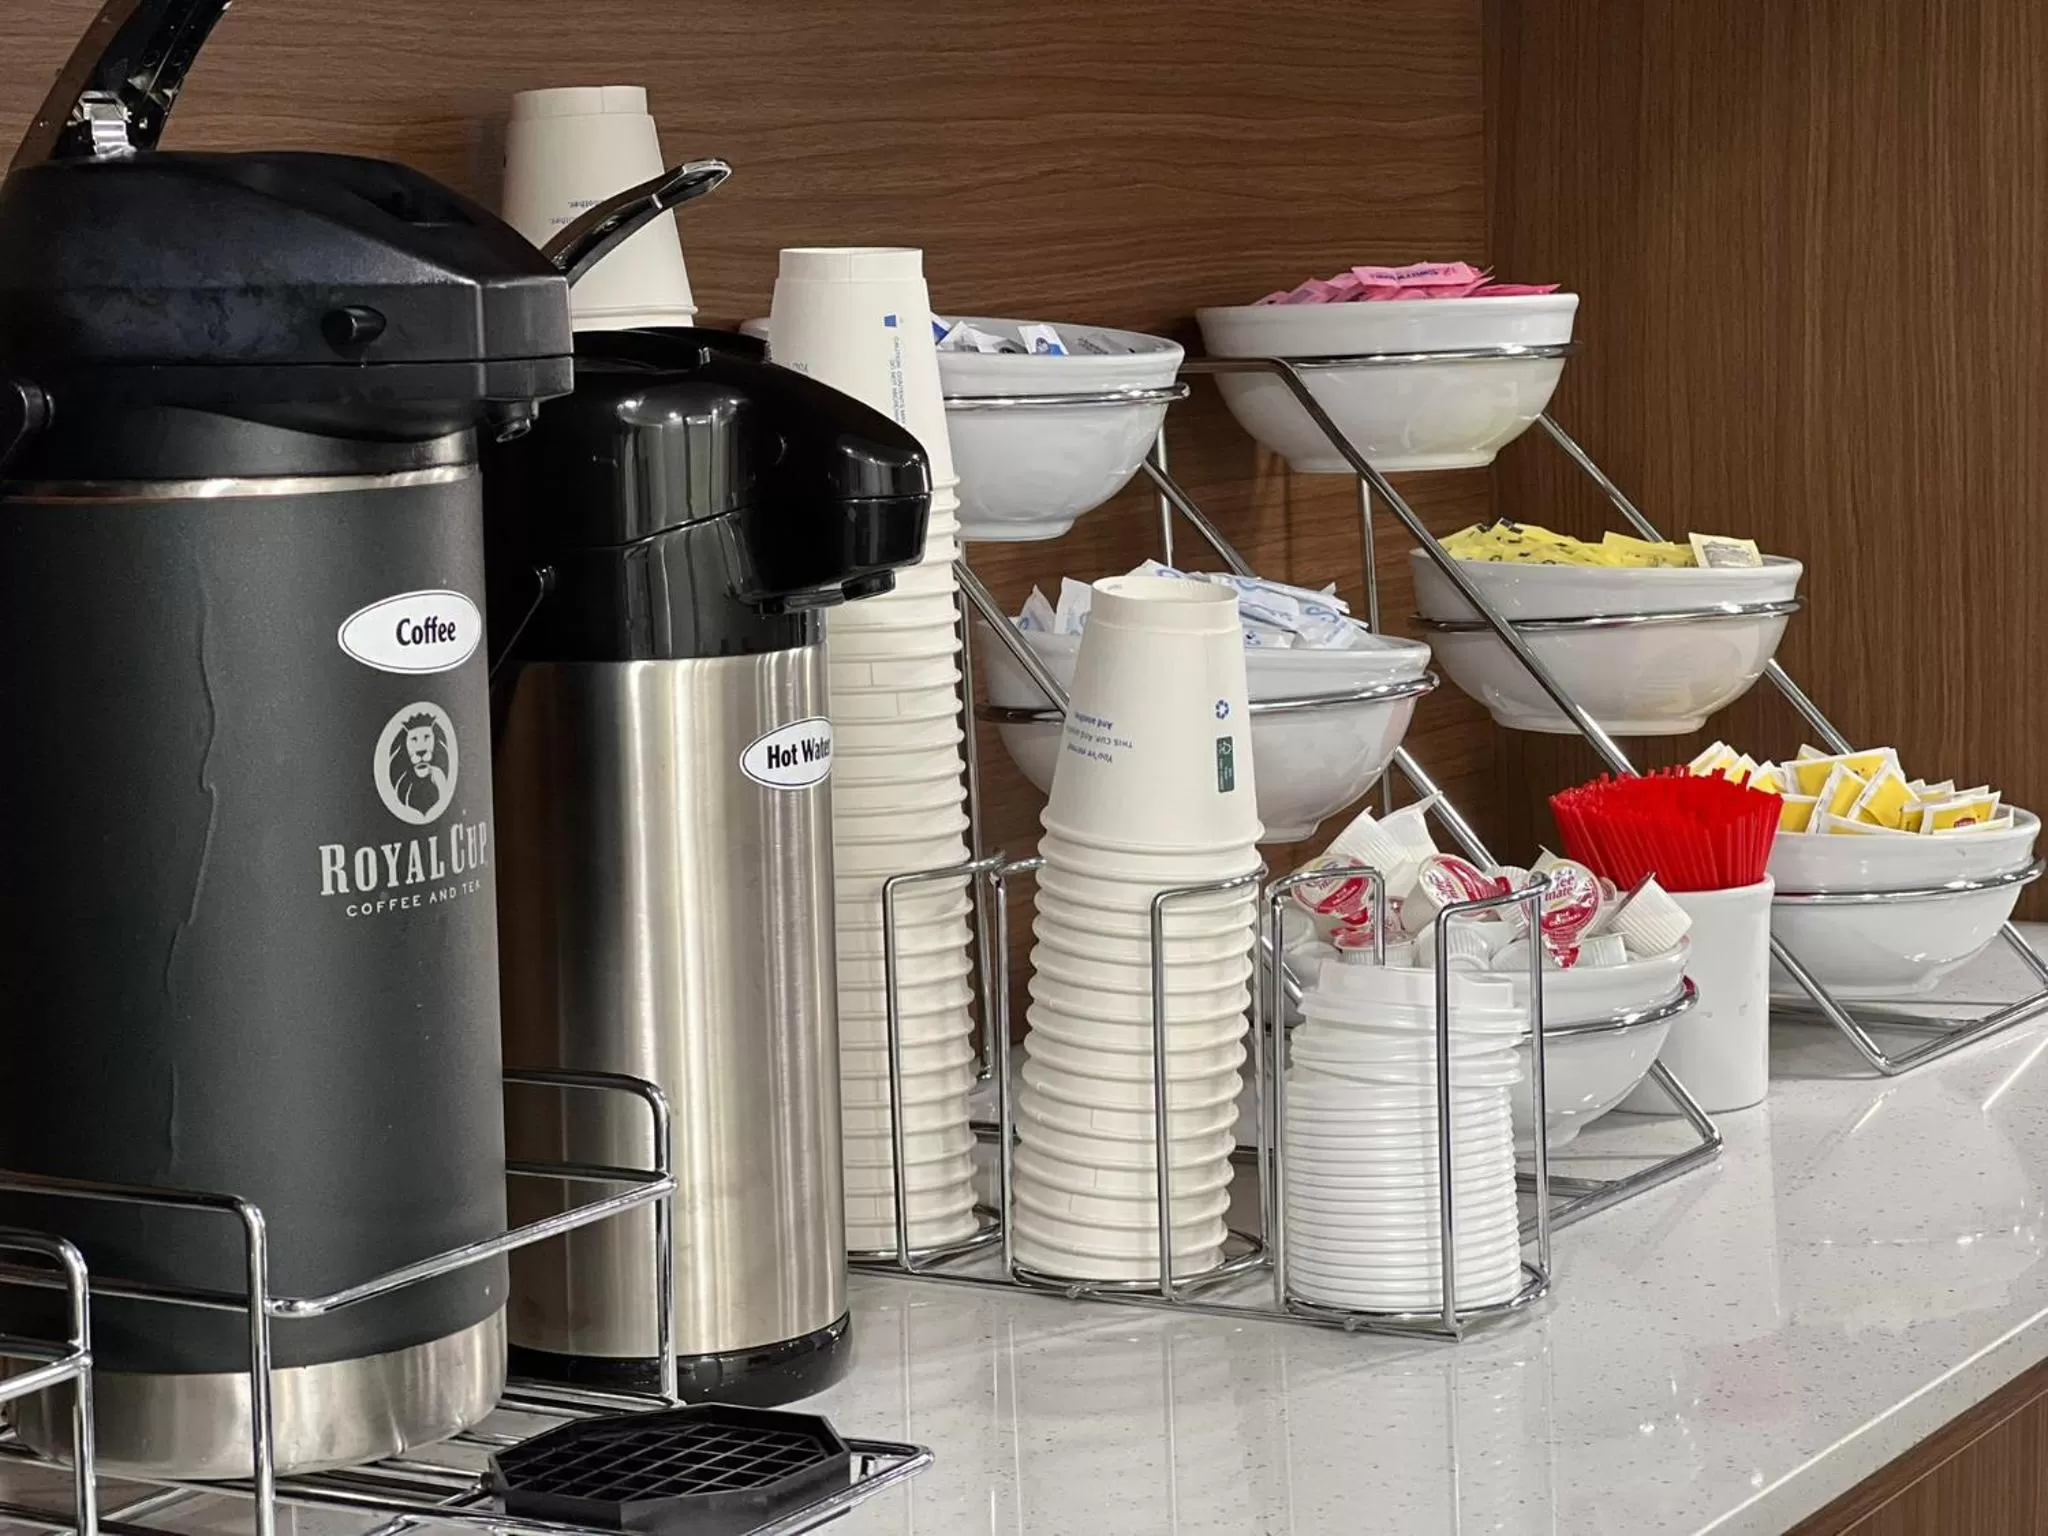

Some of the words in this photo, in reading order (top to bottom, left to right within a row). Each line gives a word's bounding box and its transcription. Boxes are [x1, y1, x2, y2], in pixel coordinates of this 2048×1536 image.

[395, 615, 457, 647] Coffee
[767, 743, 798, 770] Hot
[1113, 738, 1134, 749] THIS
[319, 836, 445, 896] ROYAL
[450, 821, 488, 875] CUP
[346, 893, 421, 918] COFFEE
[429, 886, 457, 905] AND
[462, 882, 481, 899] TEA
[1544, 886, 1573, 901] mate
